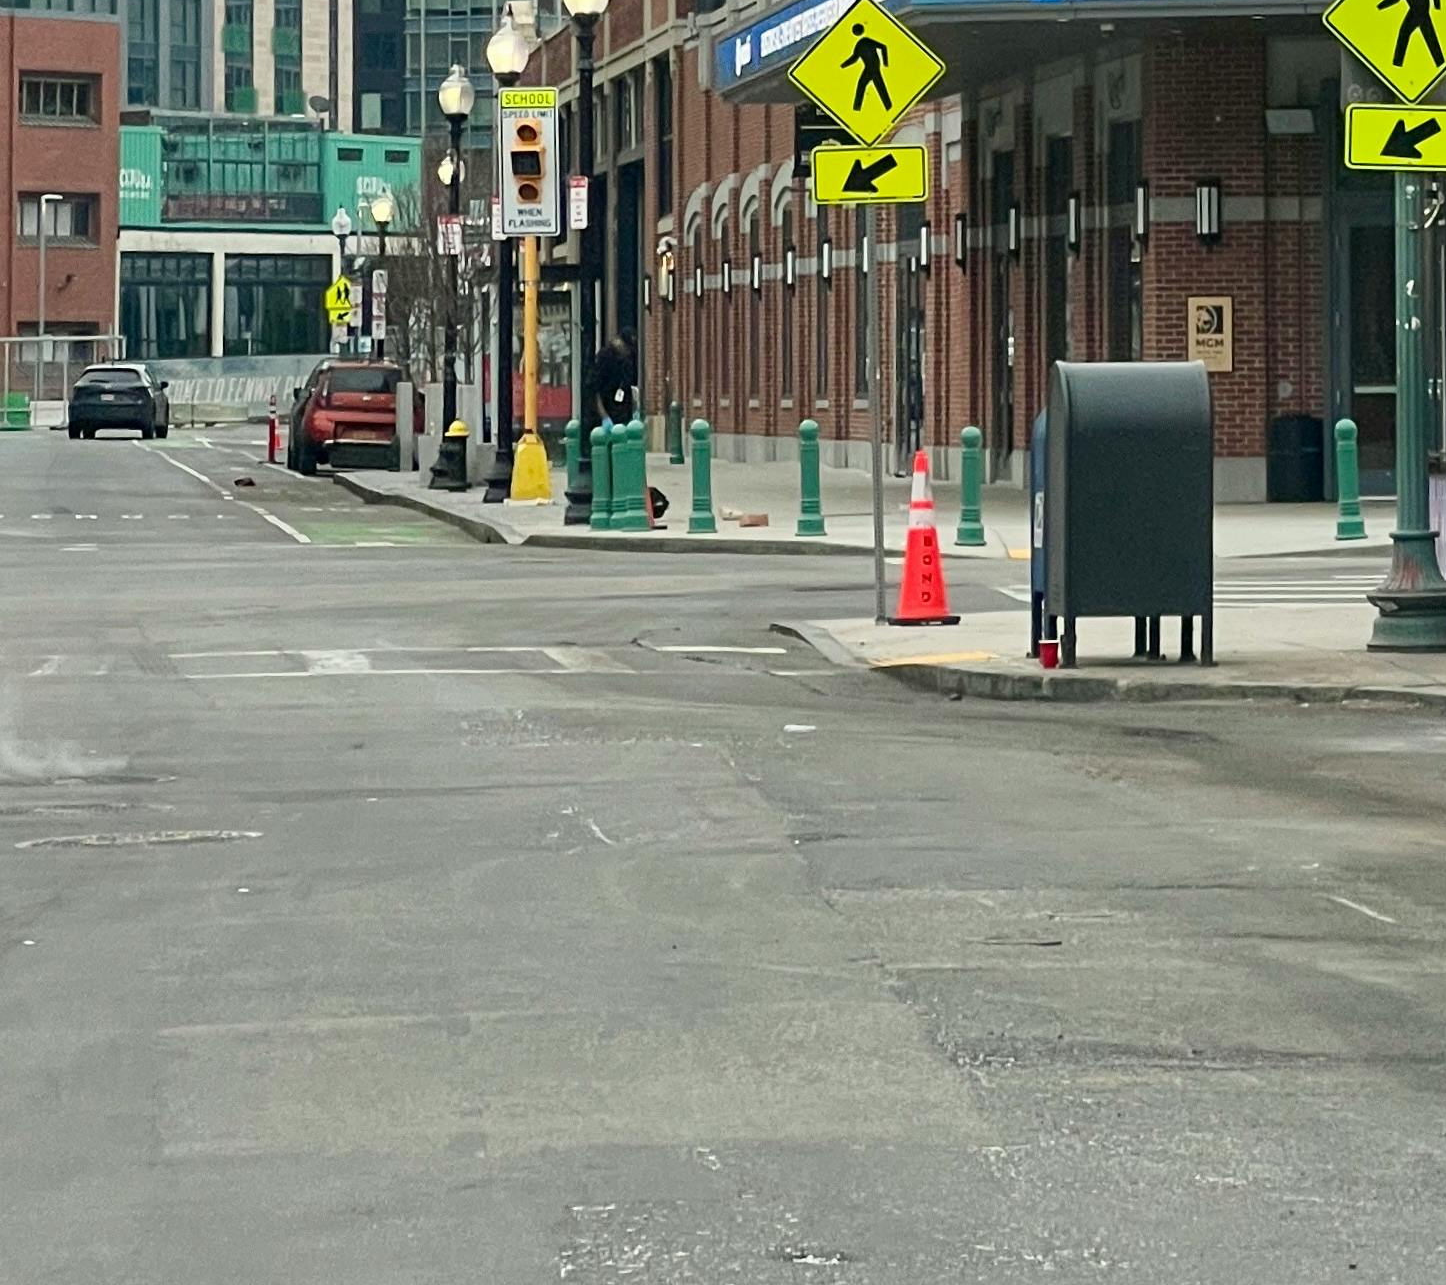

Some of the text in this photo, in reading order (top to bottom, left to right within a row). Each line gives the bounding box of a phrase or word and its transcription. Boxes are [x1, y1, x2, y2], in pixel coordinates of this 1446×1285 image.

[505, 93, 552, 105] SCHOOL
[517, 208, 542, 217] WHEN
[1196, 338, 1224, 348] MGM
